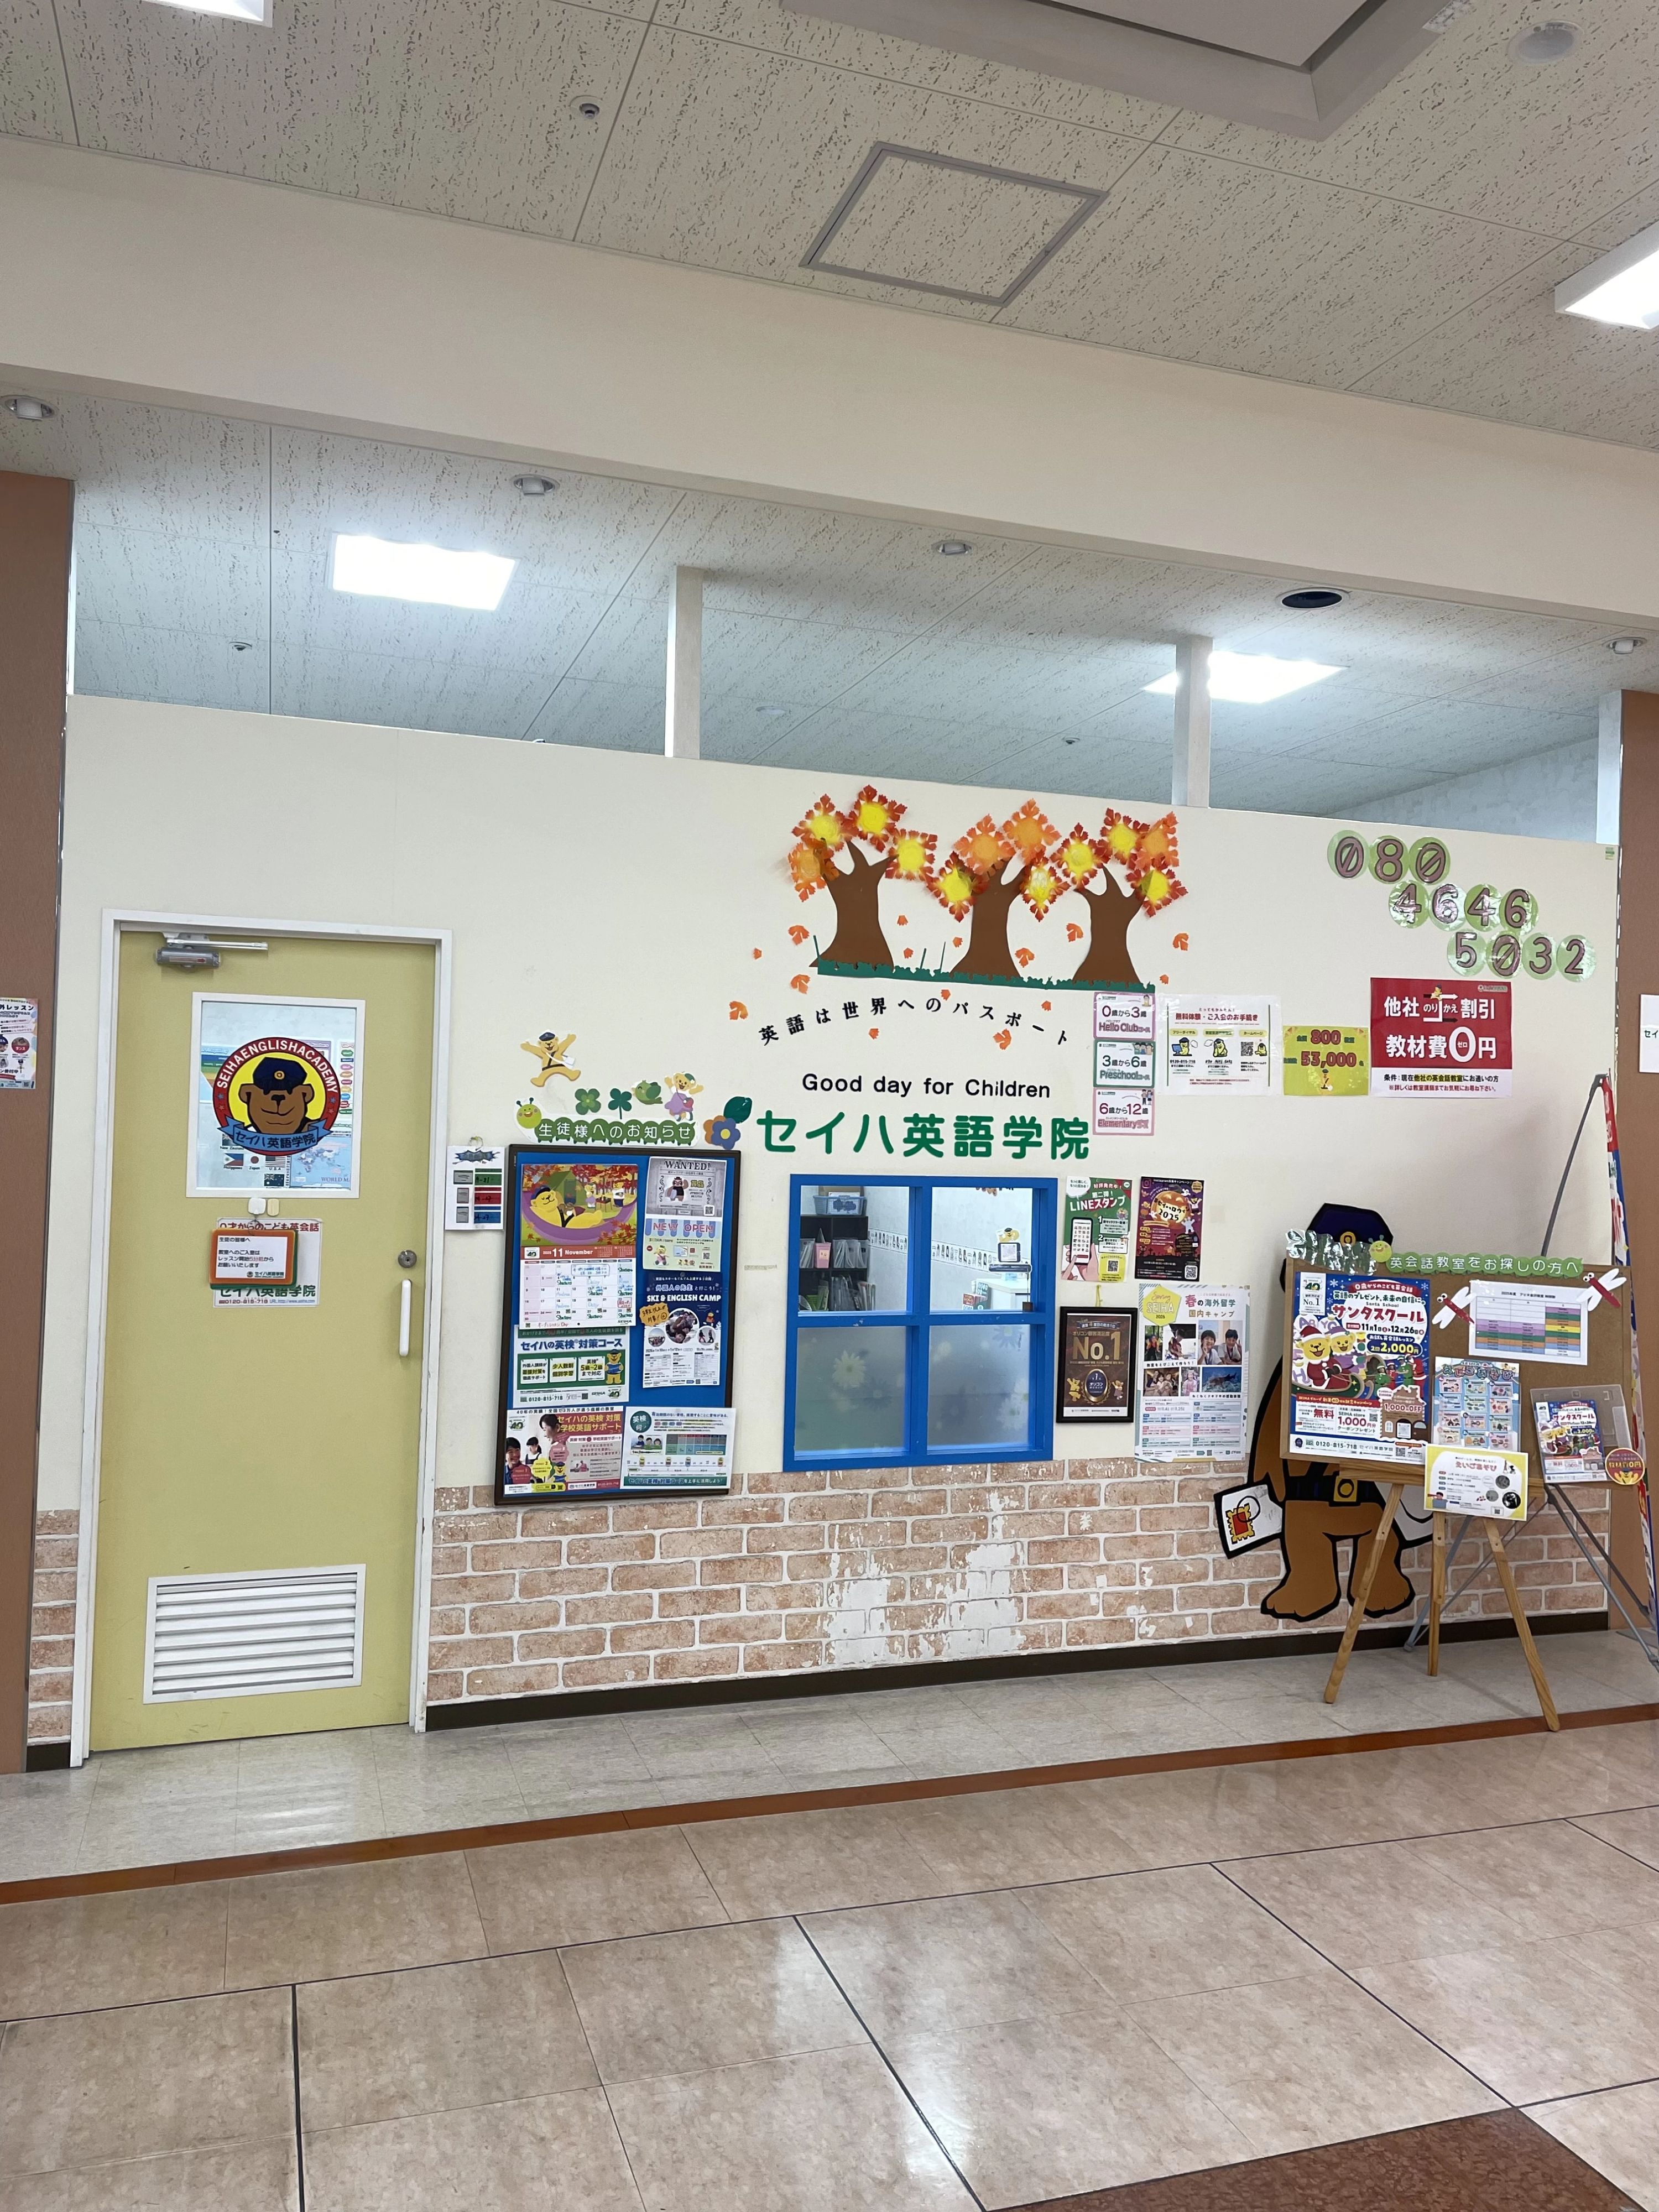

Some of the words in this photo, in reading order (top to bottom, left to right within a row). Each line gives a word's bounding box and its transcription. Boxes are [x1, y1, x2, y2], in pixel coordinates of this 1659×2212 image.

[1334, 836, 1446, 883] 080
[1394, 883, 1530, 928] 4646
[1455, 931, 1585, 977] 5032
[1102, 1005, 1147, 1018] 0歳から3歳
[1176, 1013, 1258, 1021] 無料体験・ご入会のお手続き
[759, 997, 1067, 1046] 英語は世界へのパスポート
[1099, 1022, 1119, 1032] Hello
[1311, 1029, 1341, 1045] 800
[1102, 1055, 1147, 1067] 3歳から6歳
[1301, 1051, 1357, 1068] 53,000
[802, 1073, 862, 1093] Good
[873, 1076, 912, 1098] day
[924, 1077, 954, 1095] for
[965, 1079, 1050, 1098] Children
[1099, 1103, 1149, 1115] 6歳から12歳
[538, 1121, 691, 1139] 生徒様へのお知らせ
[757, 1109, 1089, 1160] セイハ英語学院
[236, 1131, 316, 1149] セイハ英語学院
[665, 1161, 711, 1170] WANTED!
[1070, 1195, 1126, 1211] LINEスタンプ
[653, 1223, 679, 1231] NEW
[684, 1224, 714, 1233] OPEN
[552, 1248, 563, 1257] 11
[1390, 1256, 1578, 1275] 英会話教室をお探しの方へ
[220, 1285, 316, 1297] セイハ英語学院
[1146, 1301, 1175, 1314] SEIHA
[1185, 1295, 1236, 1308] 春の海外留学
[1303, 1298, 1321, 1306] No.1
[1189, 1310, 1235, 1318] 国内キャンプ
[1332, 1305, 1425, 1323] サンタスクール
[1073, 1332, 1121, 1360] No.1
[1314, 1408, 1334, 1419] 無料
[1553, 1412, 1595, 1421] サンタスクール
[560, 1423, 621, 1432] 学校英語サポート
[1316, 1441, 1357, 1449] 0120-815-718
